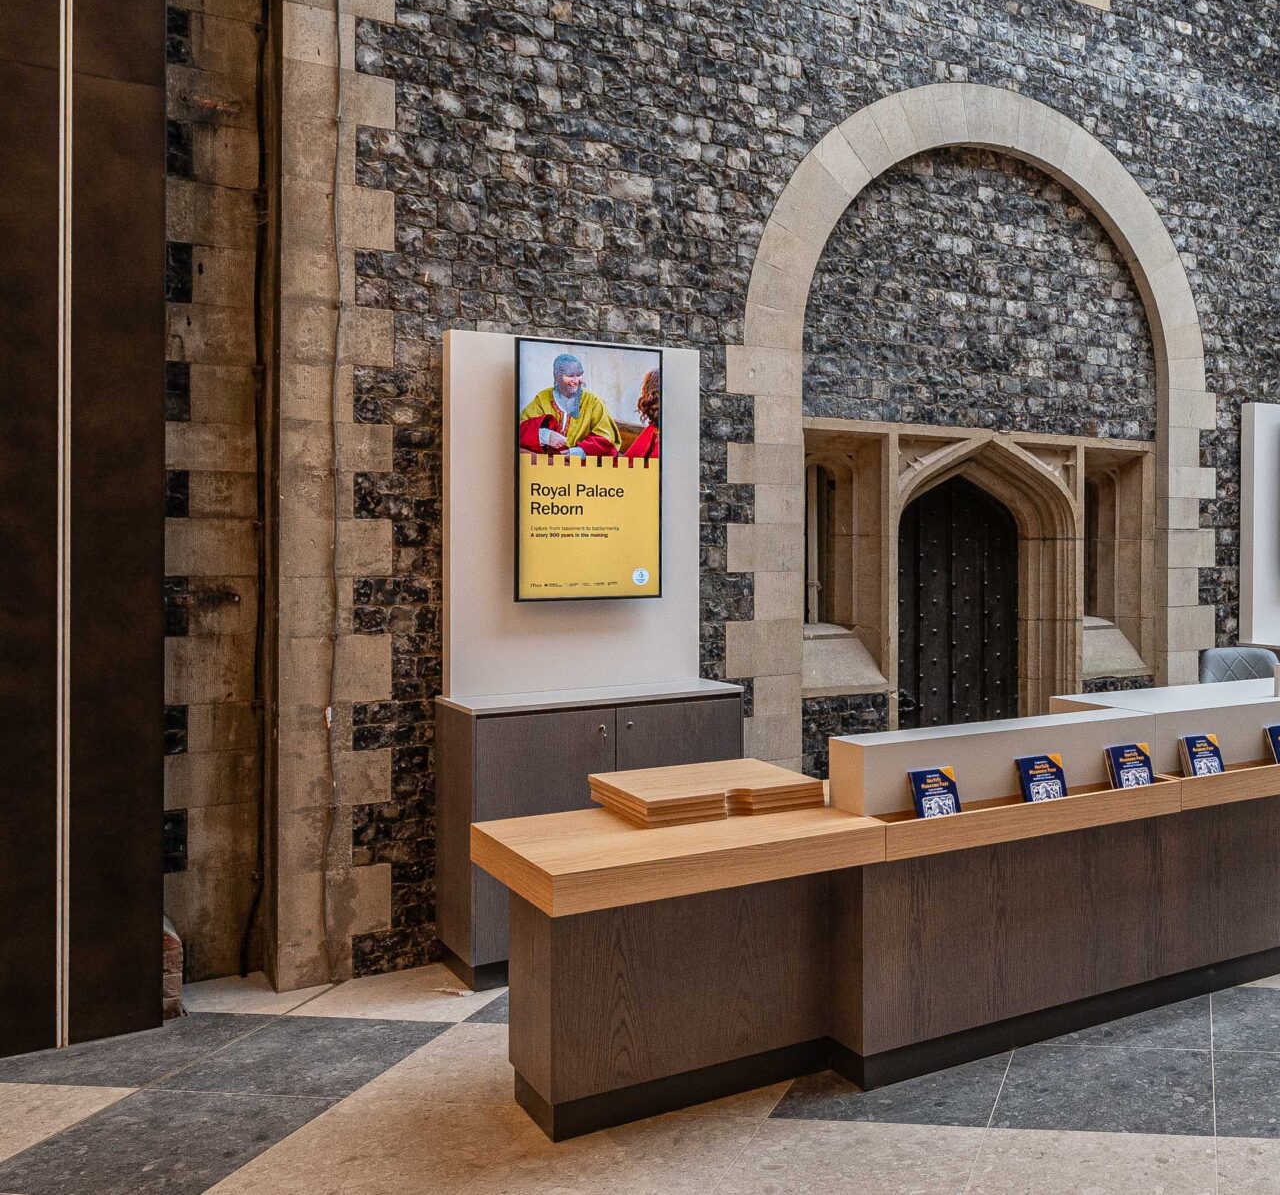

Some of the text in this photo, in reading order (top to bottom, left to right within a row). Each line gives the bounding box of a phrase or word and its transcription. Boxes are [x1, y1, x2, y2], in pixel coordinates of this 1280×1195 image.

[530, 483, 625, 500] Royal Palace
[530, 501, 584, 515] Reborn
